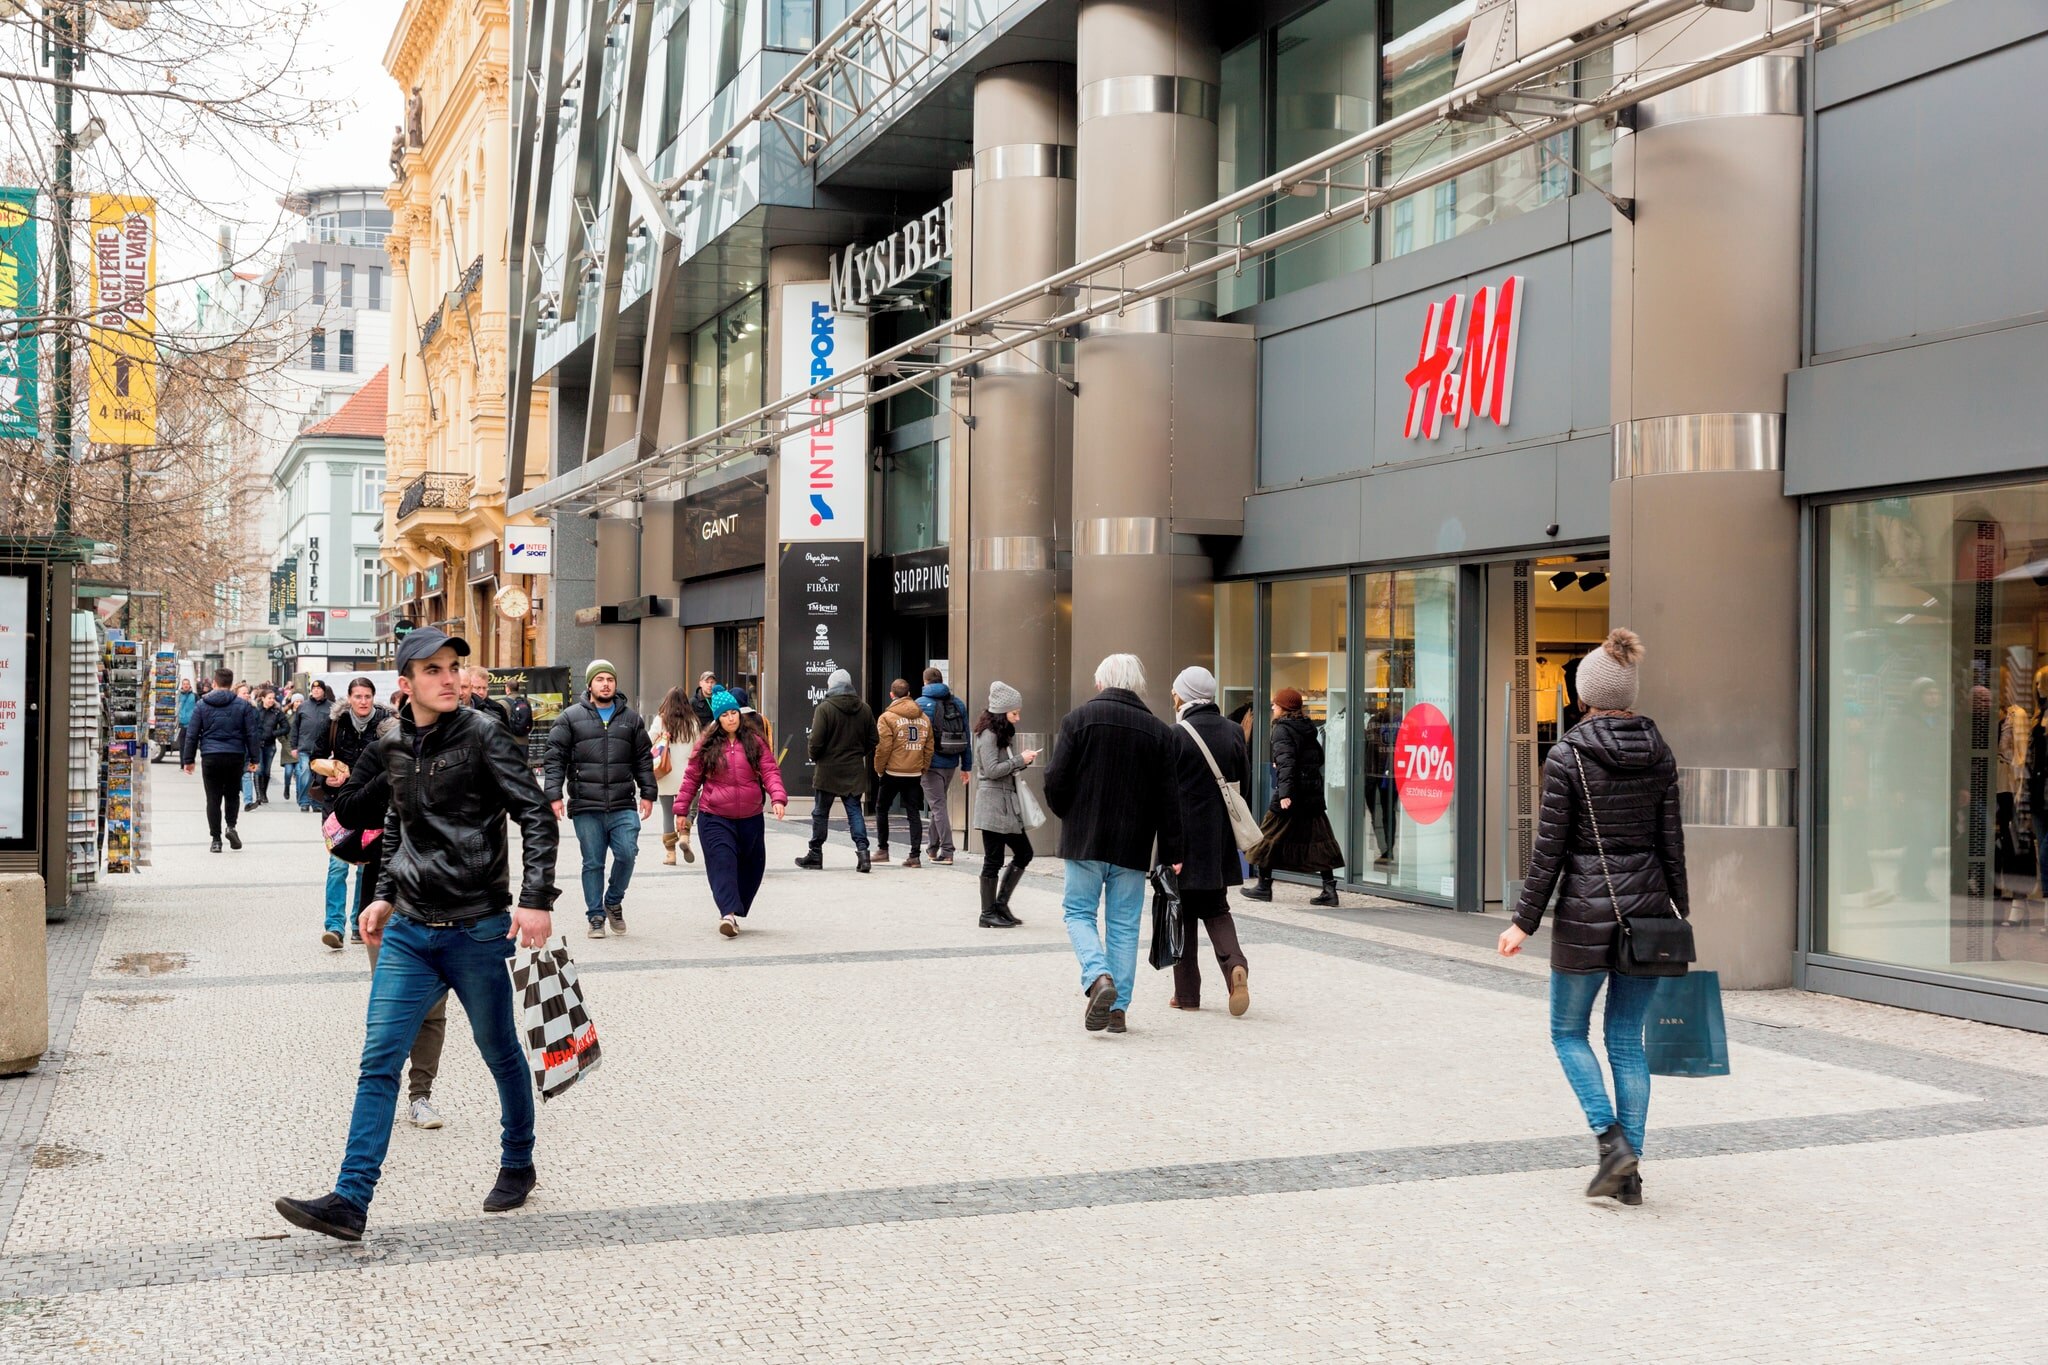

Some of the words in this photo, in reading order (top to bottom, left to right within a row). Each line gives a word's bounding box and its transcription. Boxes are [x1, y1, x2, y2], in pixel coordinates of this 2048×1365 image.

[123, 214, 148, 314] BOULEVARD
[1404, 275, 1524, 441] H&M
[99, 404, 108, 420] 4
[702, 513, 739, 541] GANT
[526, 543, 548, 551] INTER
[309, 536, 319, 602] HOTEL
[893, 563, 950, 595] SHOPPING
[289, 570, 297, 605] FRIDAY
[806, 583, 840, 593] FIBART
[908, 725, 919, 743] D
[1397, 744, 1453, 782] -70%
